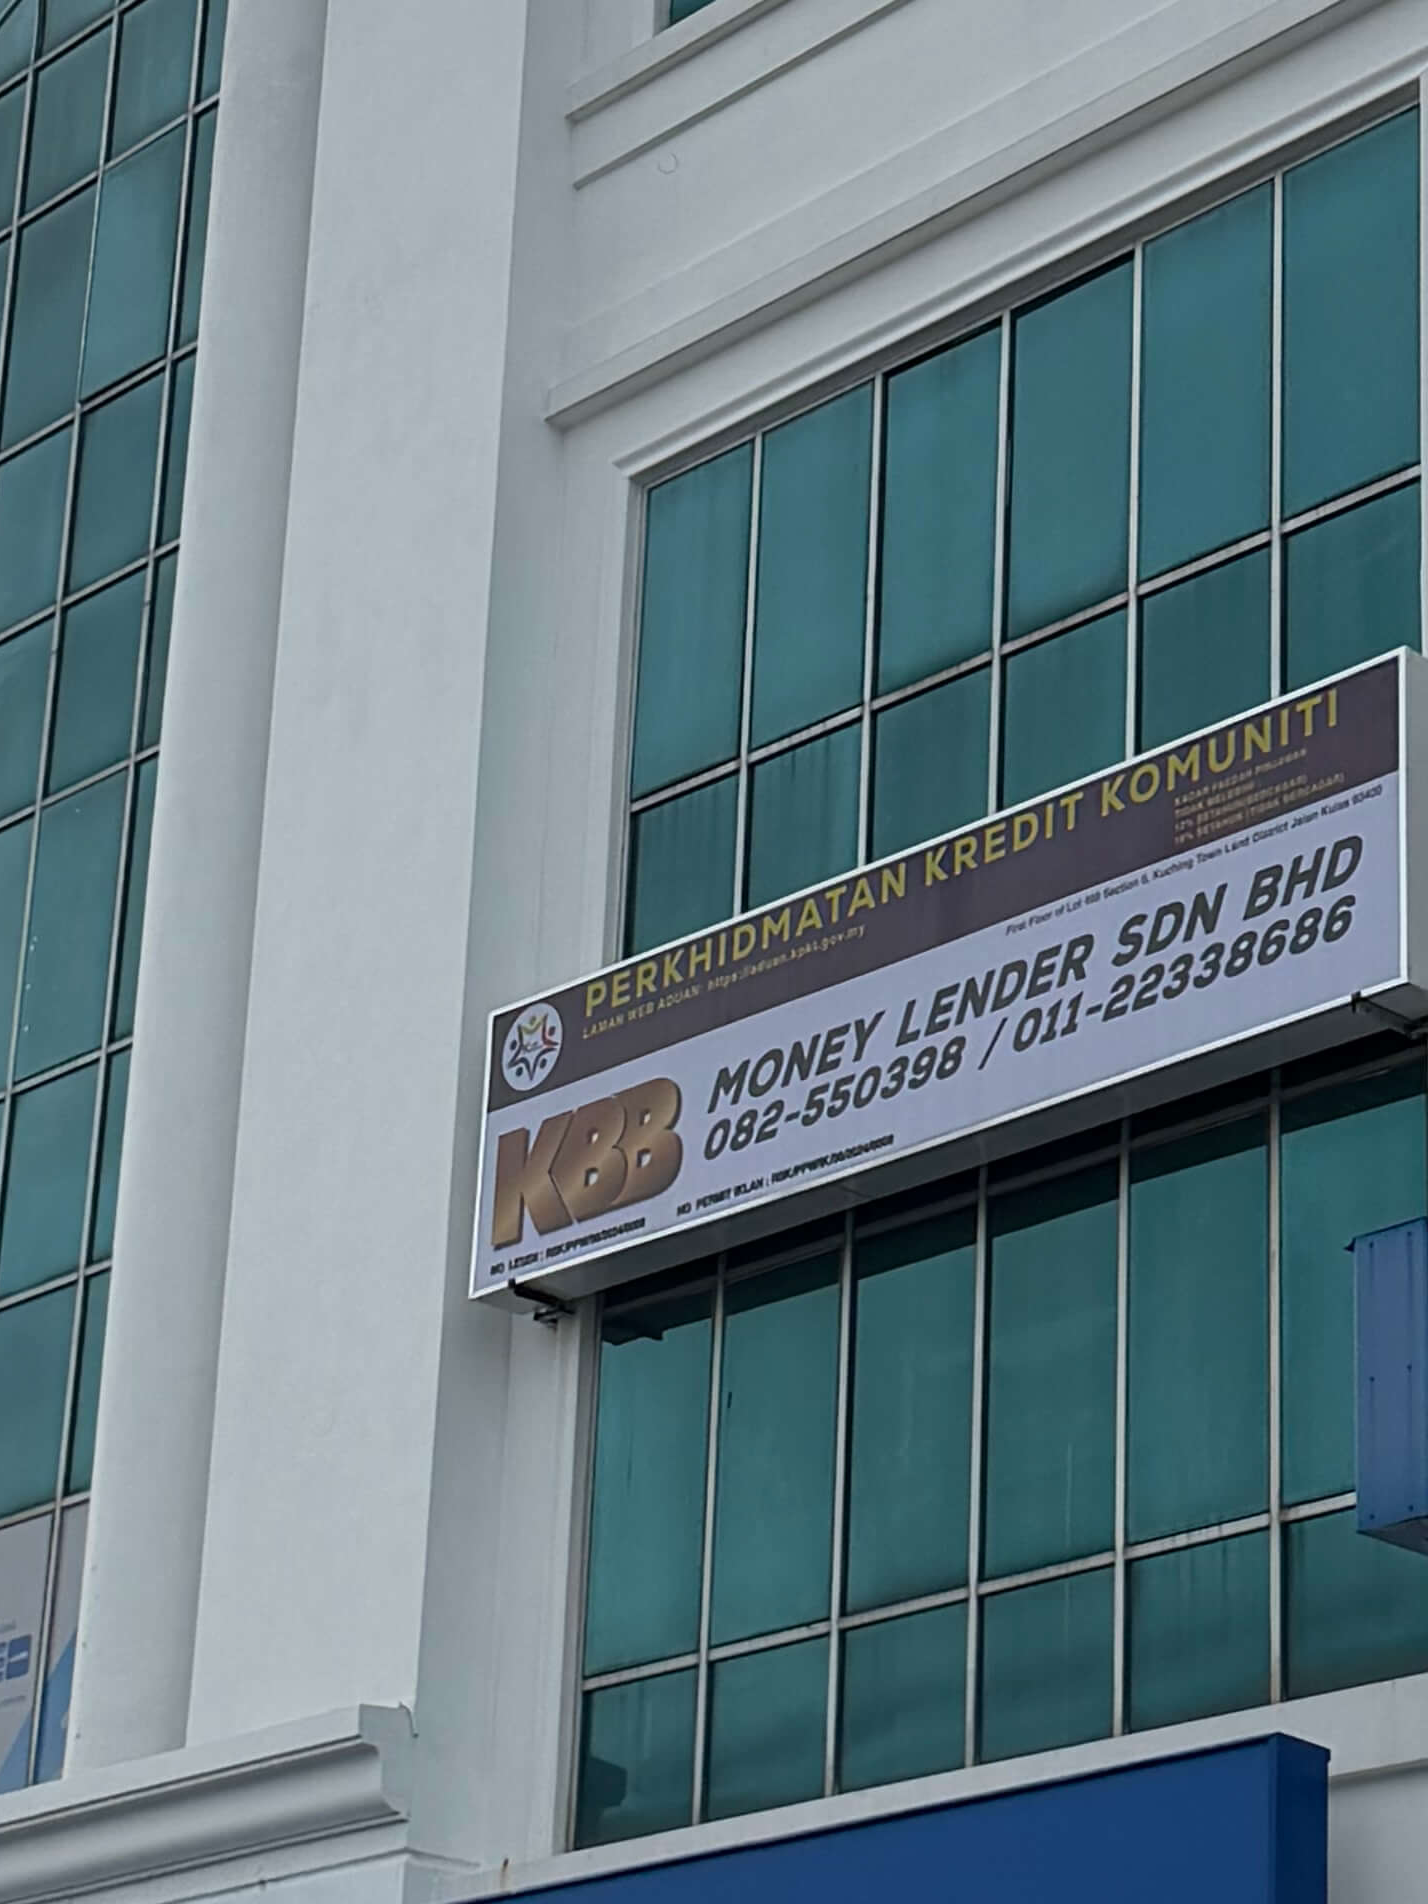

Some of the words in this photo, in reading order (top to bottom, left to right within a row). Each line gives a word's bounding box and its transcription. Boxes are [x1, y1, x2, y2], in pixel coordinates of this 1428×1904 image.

[585, 865, 906, 1018] PERKHIDMATAN
[925, 793, 1083, 886] KREDIT
[1100, 688, 1337, 816] KOMUNITI
[707, 1010, 886, 1114] MONEY
[894, 933, 1095, 1049] LENDER
[1111, 882, 1228, 967] SDN
[1242, 835, 1363, 920] BHD
[1028, 911, 1053, 928] Floor
[1066, 899, 1082, 913] Lot
[1103, 877, 1139, 899] Section
[1152, 858, 1194, 880] Kuching
[1196, 847, 1222, 863] Town
[1224, 836, 1250, 853] Land
[1252, 821, 1289, 843] District
[1290, 810, 1319, 830] Jalan
[703, 1037, 967, 1160] 082-550398
[977, 1017, 1007, 1070] /
[1011, 894, 1357, 1053] 011-22338686
[492, 1077, 683, 1251] KBB
